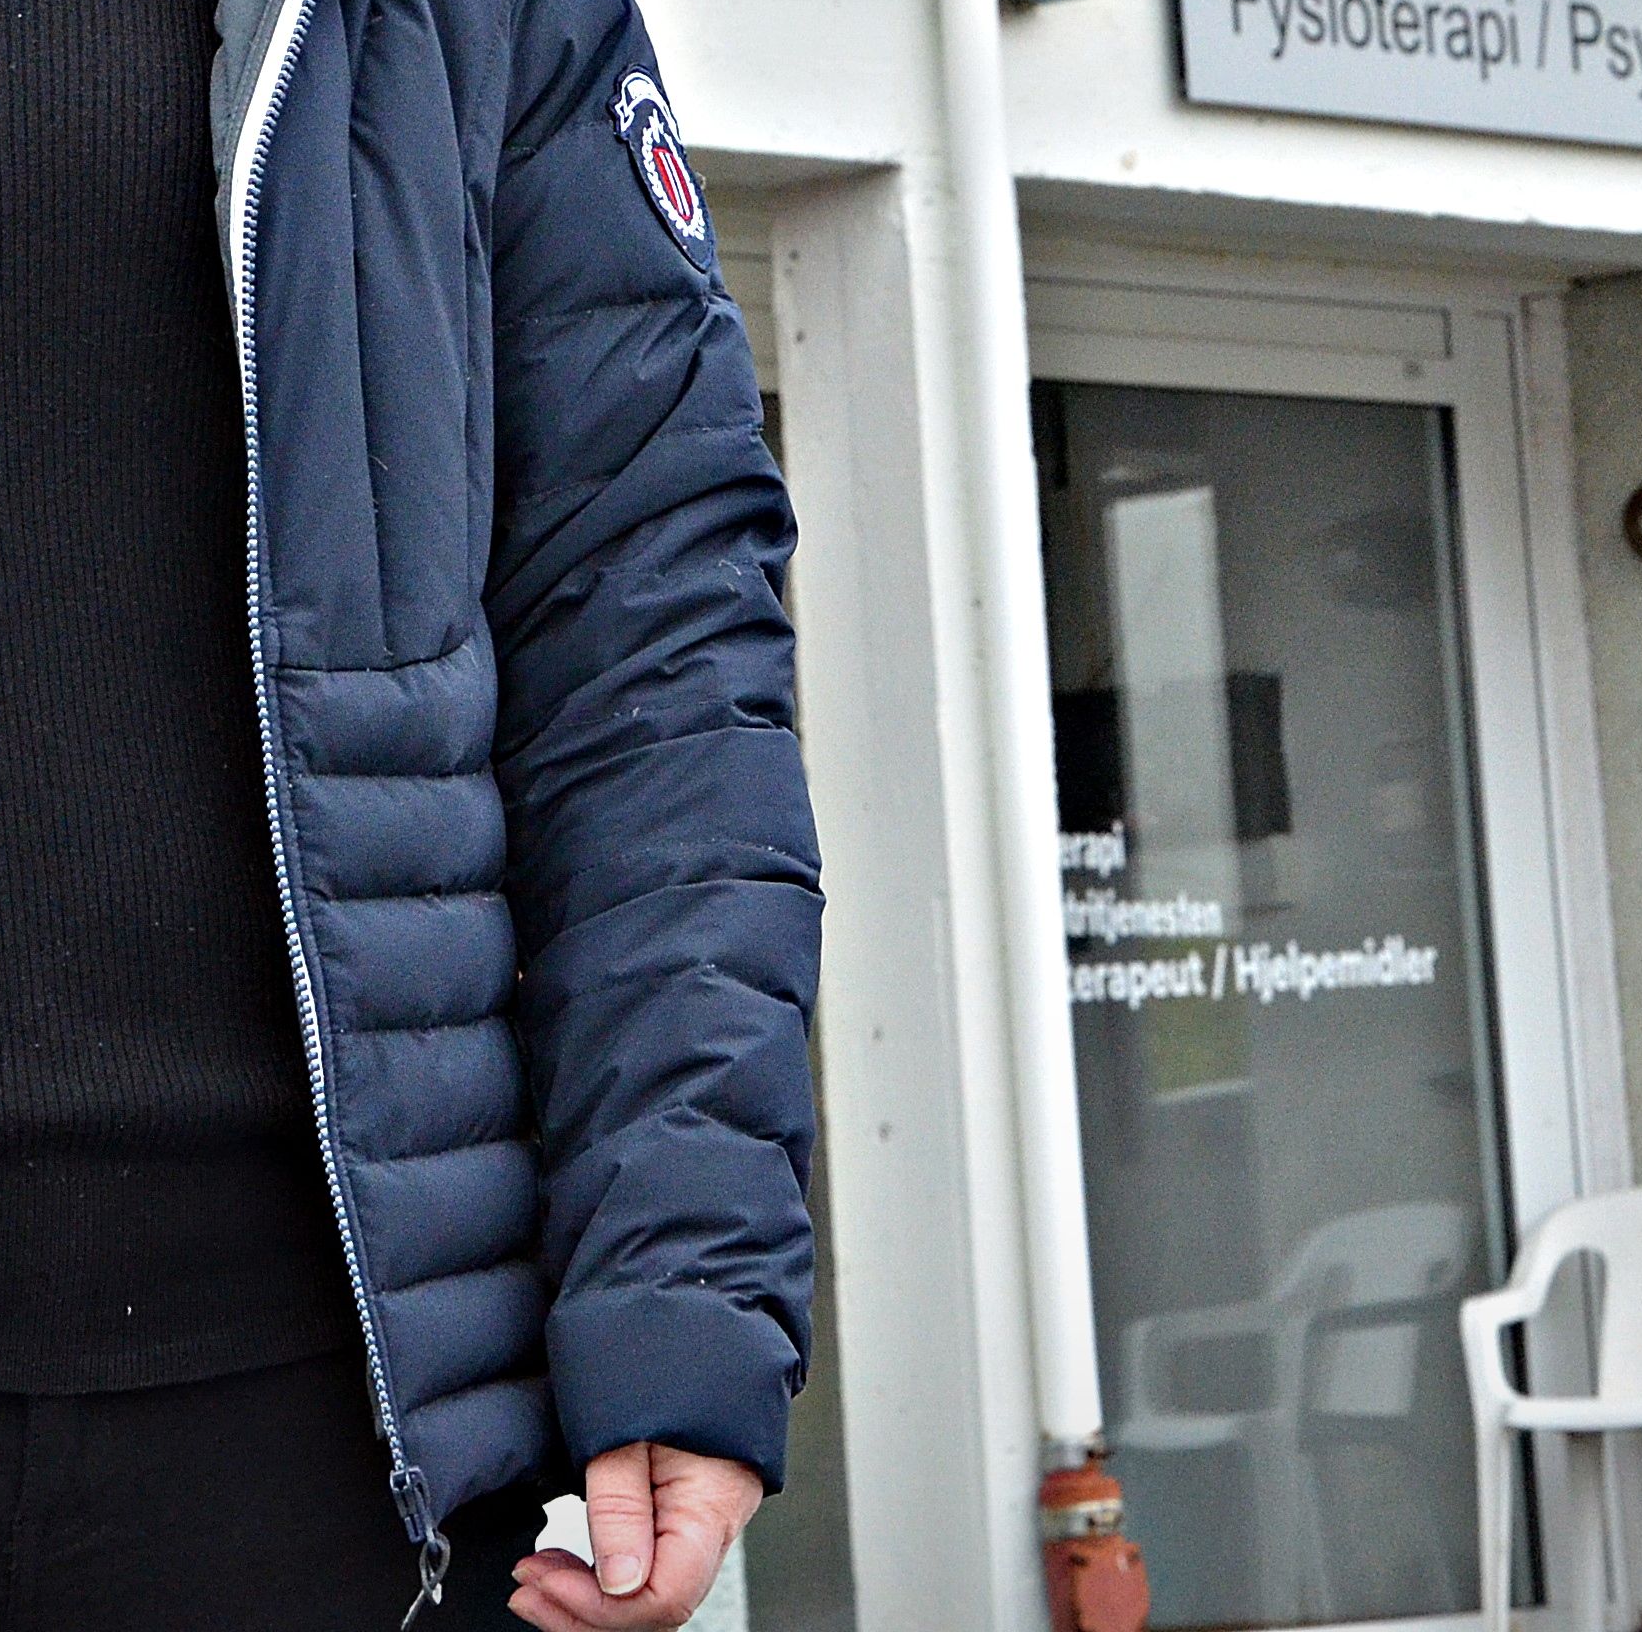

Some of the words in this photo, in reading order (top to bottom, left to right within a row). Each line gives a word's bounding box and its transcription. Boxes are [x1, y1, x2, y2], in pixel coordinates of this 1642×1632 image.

[1058, 819, 1126, 879] erapi
[1068, 950, 1207, 1011] erapeut
[1210, 942, 1229, 1001] /
[1232, 933, 1438, 1005] Hjelpemidler
